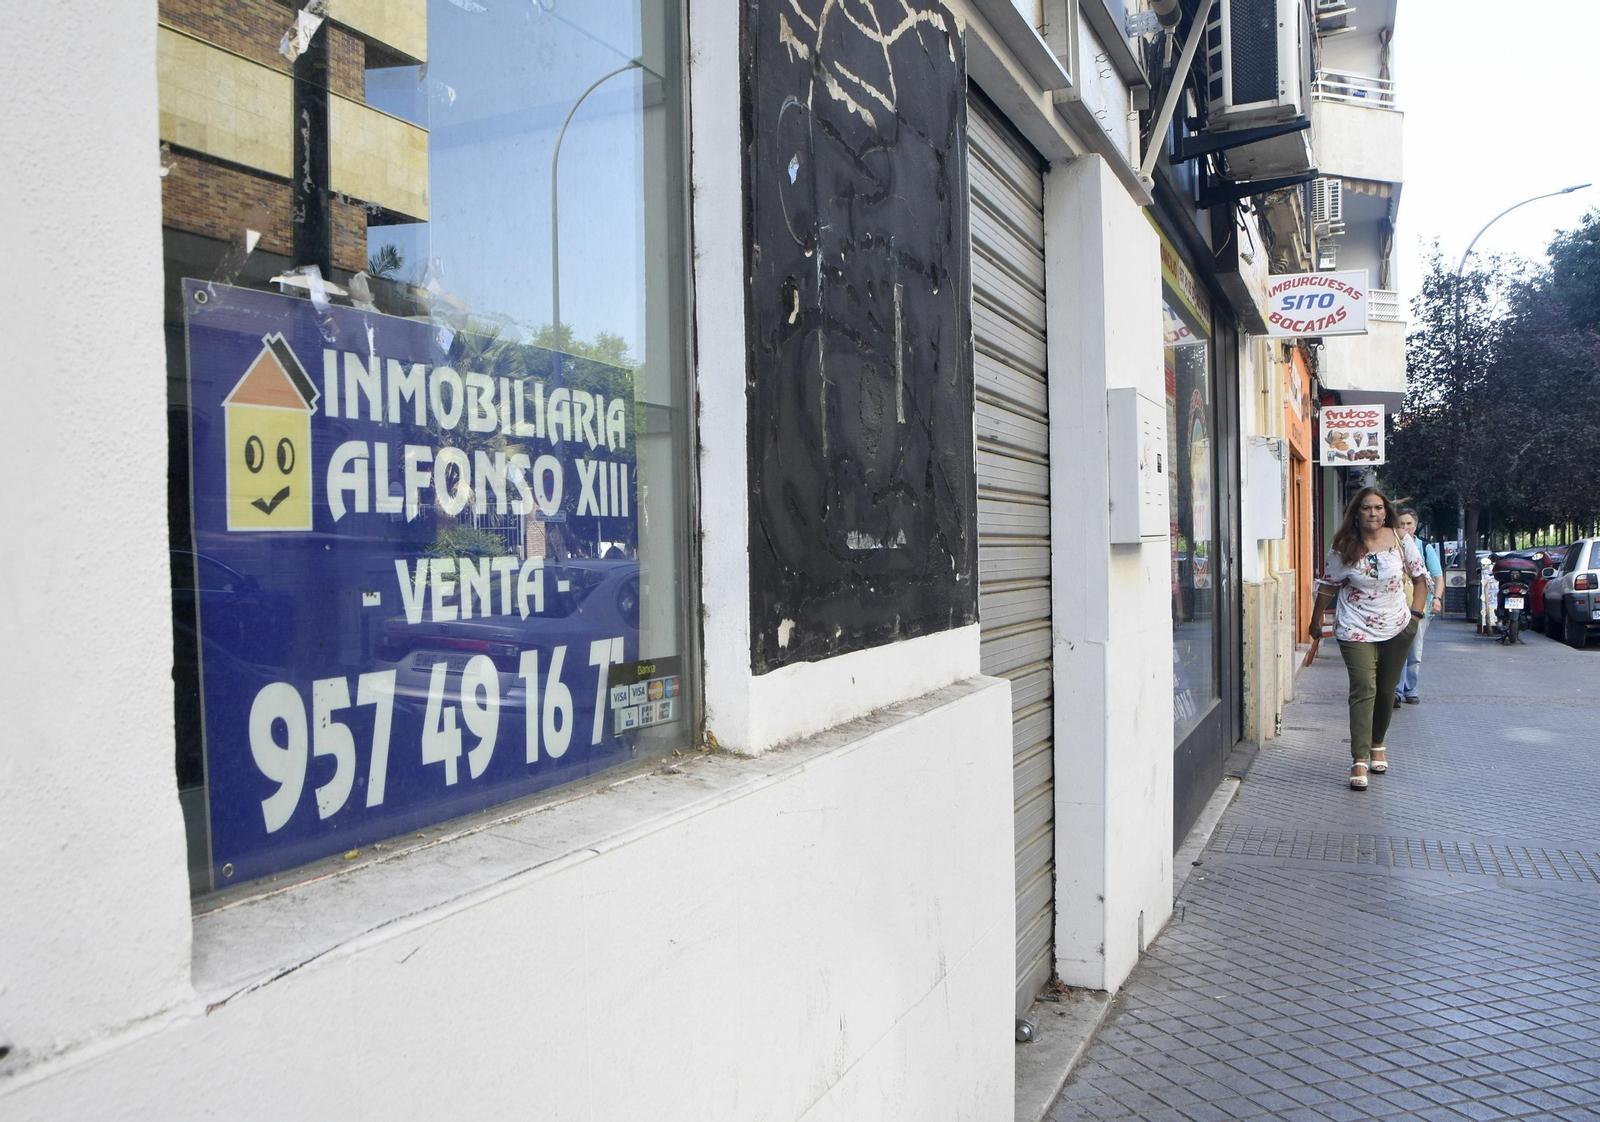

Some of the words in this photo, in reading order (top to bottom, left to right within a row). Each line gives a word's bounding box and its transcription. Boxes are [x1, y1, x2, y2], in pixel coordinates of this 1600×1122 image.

[1281, 293, 1335, 311] SITO
[1269, 306, 1347, 332] BOCATAS
[323, 348, 626, 453] INMOBILIARIA
[1325, 409, 1380, 420] frutos
[1325, 419, 1379, 429] secos
[326, 440, 564, 524] ALFONSO
[575, 457, 629, 518] XIII
[394, 556, 545, 625] VENTA
[613, 691, 628, 703] VISA
[631, 686, 646, 698] VISA
[249, 669, 397, 834] 957
[421, 654, 501, 787] 49
[518, 644, 574, 765] 16
